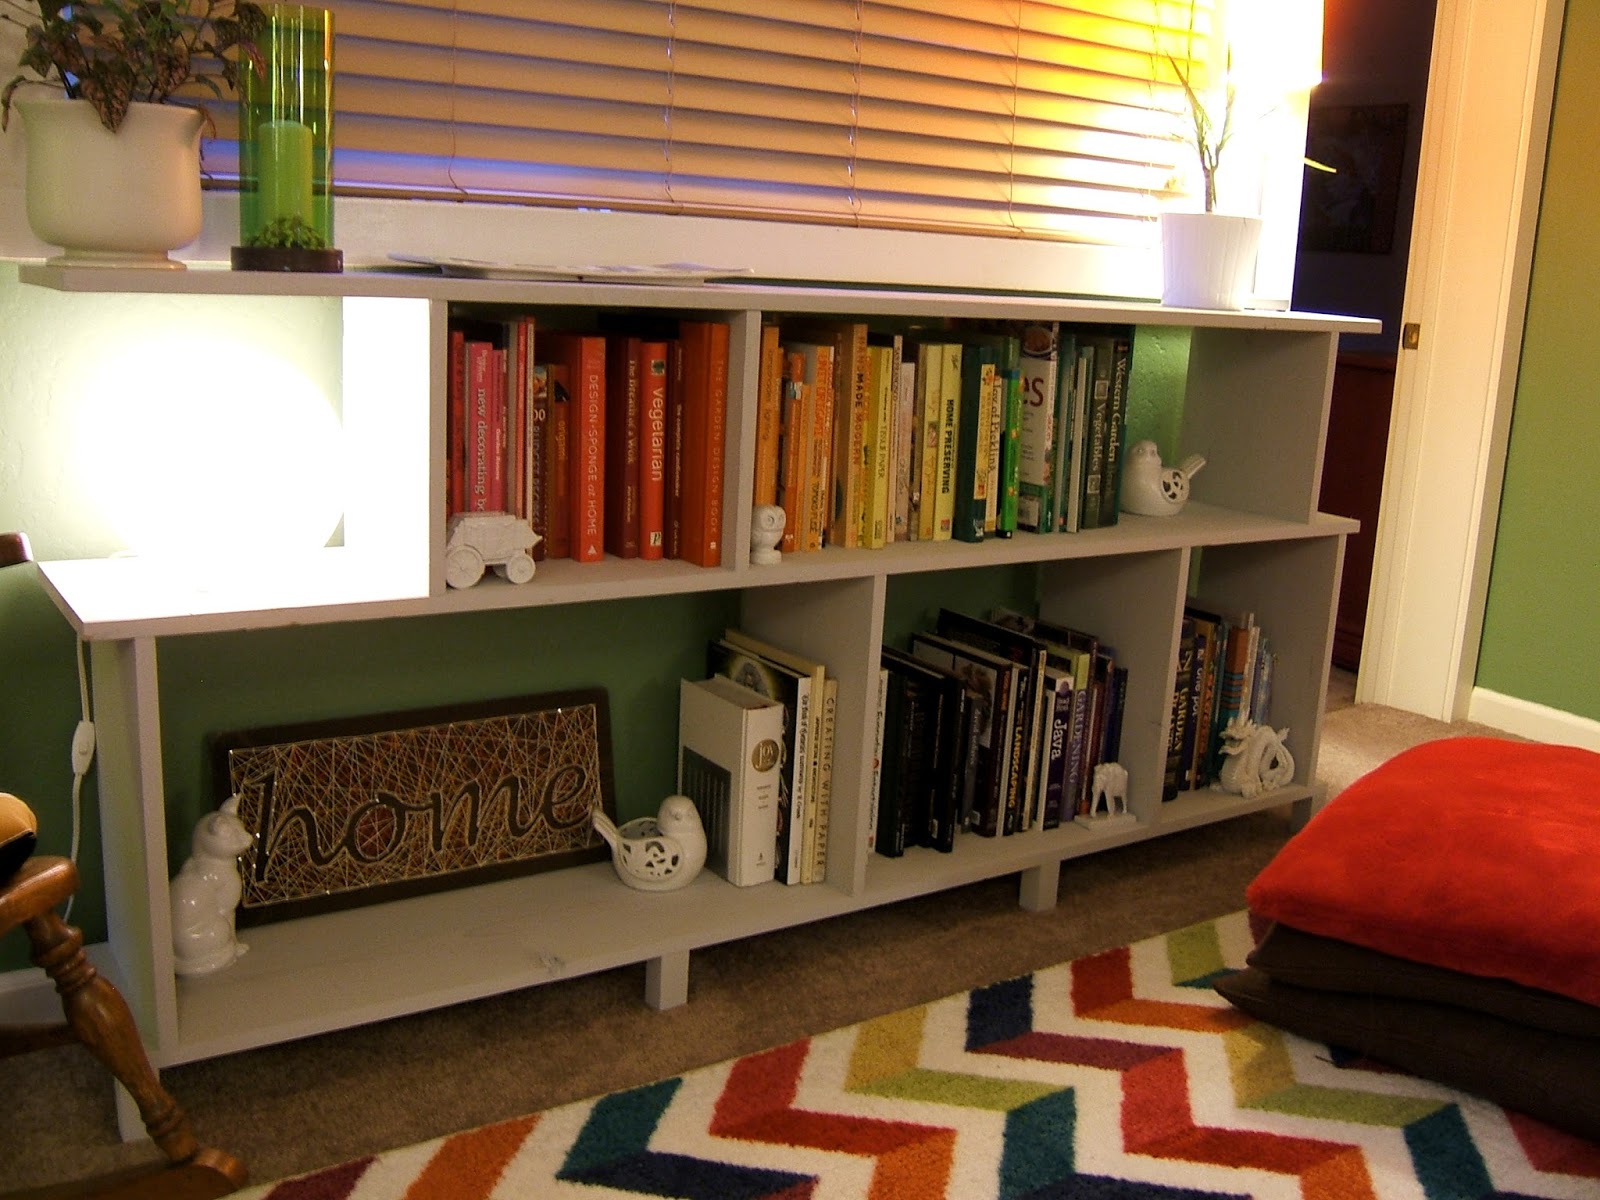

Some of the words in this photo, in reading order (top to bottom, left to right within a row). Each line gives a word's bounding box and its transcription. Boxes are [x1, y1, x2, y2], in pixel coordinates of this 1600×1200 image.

[715, 360, 723, 382] THE
[1112, 357, 1127, 410] Western
[477, 388, 486, 416] new
[713, 390, 723, 441] GARDEN
[945, 399, 954, 428] HOME
[474, 420, 488, 494] decorating
[648, 387, 665, 482] vegetarian
[853, 413, 862, 466] MODERN
[879, 425, 887, 451] TISSUE
[988, 422, 999, 474] Pickling
[1092, 403, 1106, 471] Vegetables
[1107, 412, 1121, 462] Garden
[711, 448, 720, 493] DESIGN
[878, 453, 886, 480] PAPER
[942, 430, 952, 494] PRESERVING
[587, 500, 597, 535] HOME
[710, 499, 718, 534] BOOK
[1194, 667, 1203, 691] one
[822, 698, 834, 772] CREATING
[1051, 719, 1067, 760] Java
[1068, 690, 1087, 783] GARDENING
[1174, 687, 1189, 751] GARDEN
[1008, 726, 1022, 808] LANDSCAPING
[245, 764, 598, 883] home
[819, 781, 829, 817] WITH
[816, 825, 827, 867] PAPER
